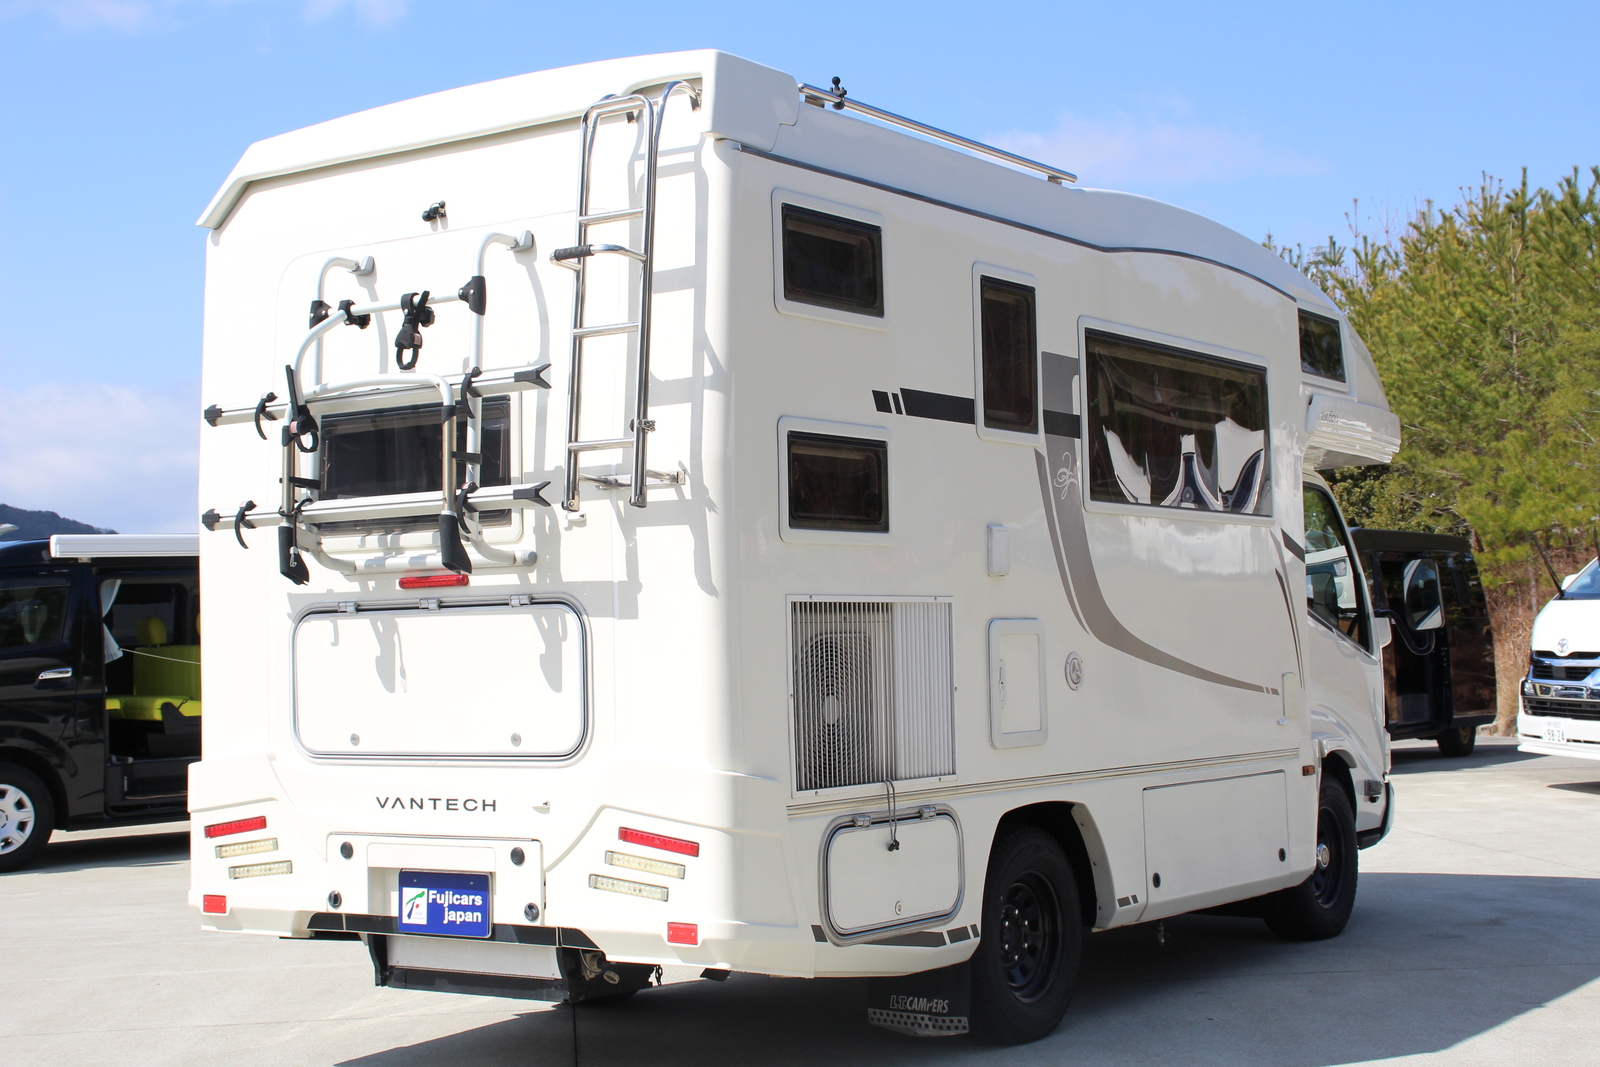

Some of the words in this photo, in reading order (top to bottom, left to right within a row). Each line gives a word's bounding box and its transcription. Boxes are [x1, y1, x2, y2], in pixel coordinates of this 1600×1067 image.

[376, 797, 497, 813] VANTECH
[430, 890, 482, 907] Fujicars
[444, 908, 482, 925] japan
